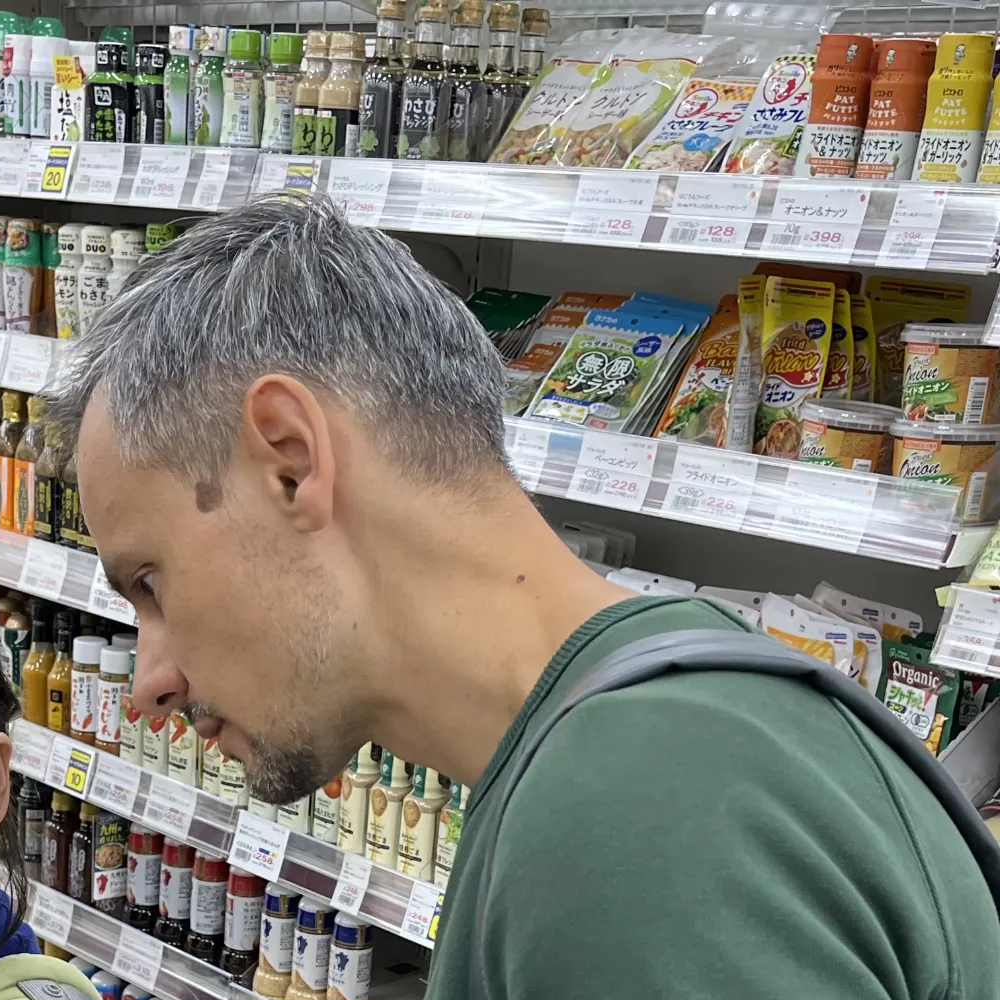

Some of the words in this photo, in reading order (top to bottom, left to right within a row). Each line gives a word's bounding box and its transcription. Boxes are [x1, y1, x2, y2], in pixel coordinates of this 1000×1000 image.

[943, 88, 964, 96] ピエトロ
[592, 92, 647, 109] クルトン
[834, 94, 856, 104] PAT
[873, 99, 892, 108] PAT
[942, 98, 962, 107] PAT
[404, 98, 437, 115] わさび
[825, 102, 858, 113] FUTTE
[935, 106, 967, 117] FUTTE
[699, 111, 744, 123] チキン
[752, 108, 807, 123] ささみフレ
[662, 120, 734, 132] ささみフレーク
[302, 123, 317, 155] わさ
[320, 126, 334, 156] わさ
[861, 138, 903, 151] ライドオニオン
[921, 138, 972, 151] フライドオニオン
[829, 146, 851, 159] ナッツ
[866, 152, 887, 163] ナッツ
[928, 151, 962, 164] ガーリック
[47, 172, 61, 186] 20
[451, 209, 472, 219] 128
[784, 205, 848, 218] オニオン&ナッツ
[607, 219, 632, 230] 128
[707, 225, 735, 237] 128
[809, 230, 841, 243] 398
[86, 243, 106, 252] DUO
[781, 337, 807, 349] Fried
[701, 341, 737, 359] Ba
[580, 354, 632, 378] 無限
[706, 359, 737, 368] FLAV
[903, 364, 938, 386] Onion
[567, 373, 626, 395] サラダ
[764, 390, 795, 403] オニオン
[801, 443, 824, 458] nion
[594, 455, 638, 469] ベーコンビッツ
[901, 459, 940, 478] Onion
[685, 470, 739, 487] フライドオニオン
[611, 480, 637, 492] 228
[708, 496, 734, 510] 228
[893, 660, 939, 688] Organic
[71, 772, 81, 785] 10
[256, 853, 274, 865] 258
[412, 912, 428, 923] 248
